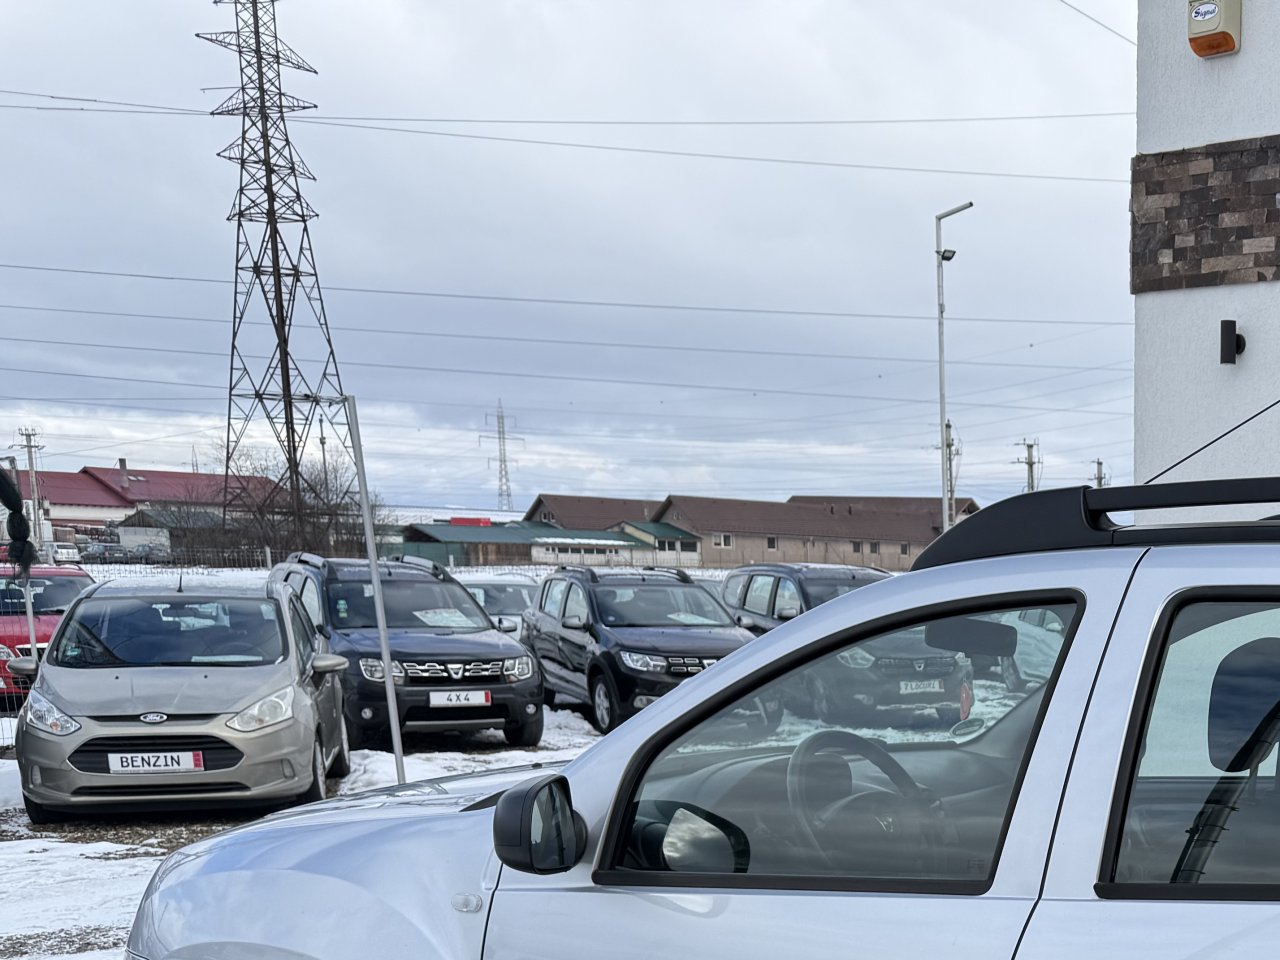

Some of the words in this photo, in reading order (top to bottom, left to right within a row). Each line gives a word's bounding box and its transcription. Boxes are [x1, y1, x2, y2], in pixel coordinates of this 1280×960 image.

[1194, 4, 1217, 19] Signal
[446, 693, 453, 702] 4
[464, 693, 470, 702] 4
[120, 755, 181, 768] BENZIN
